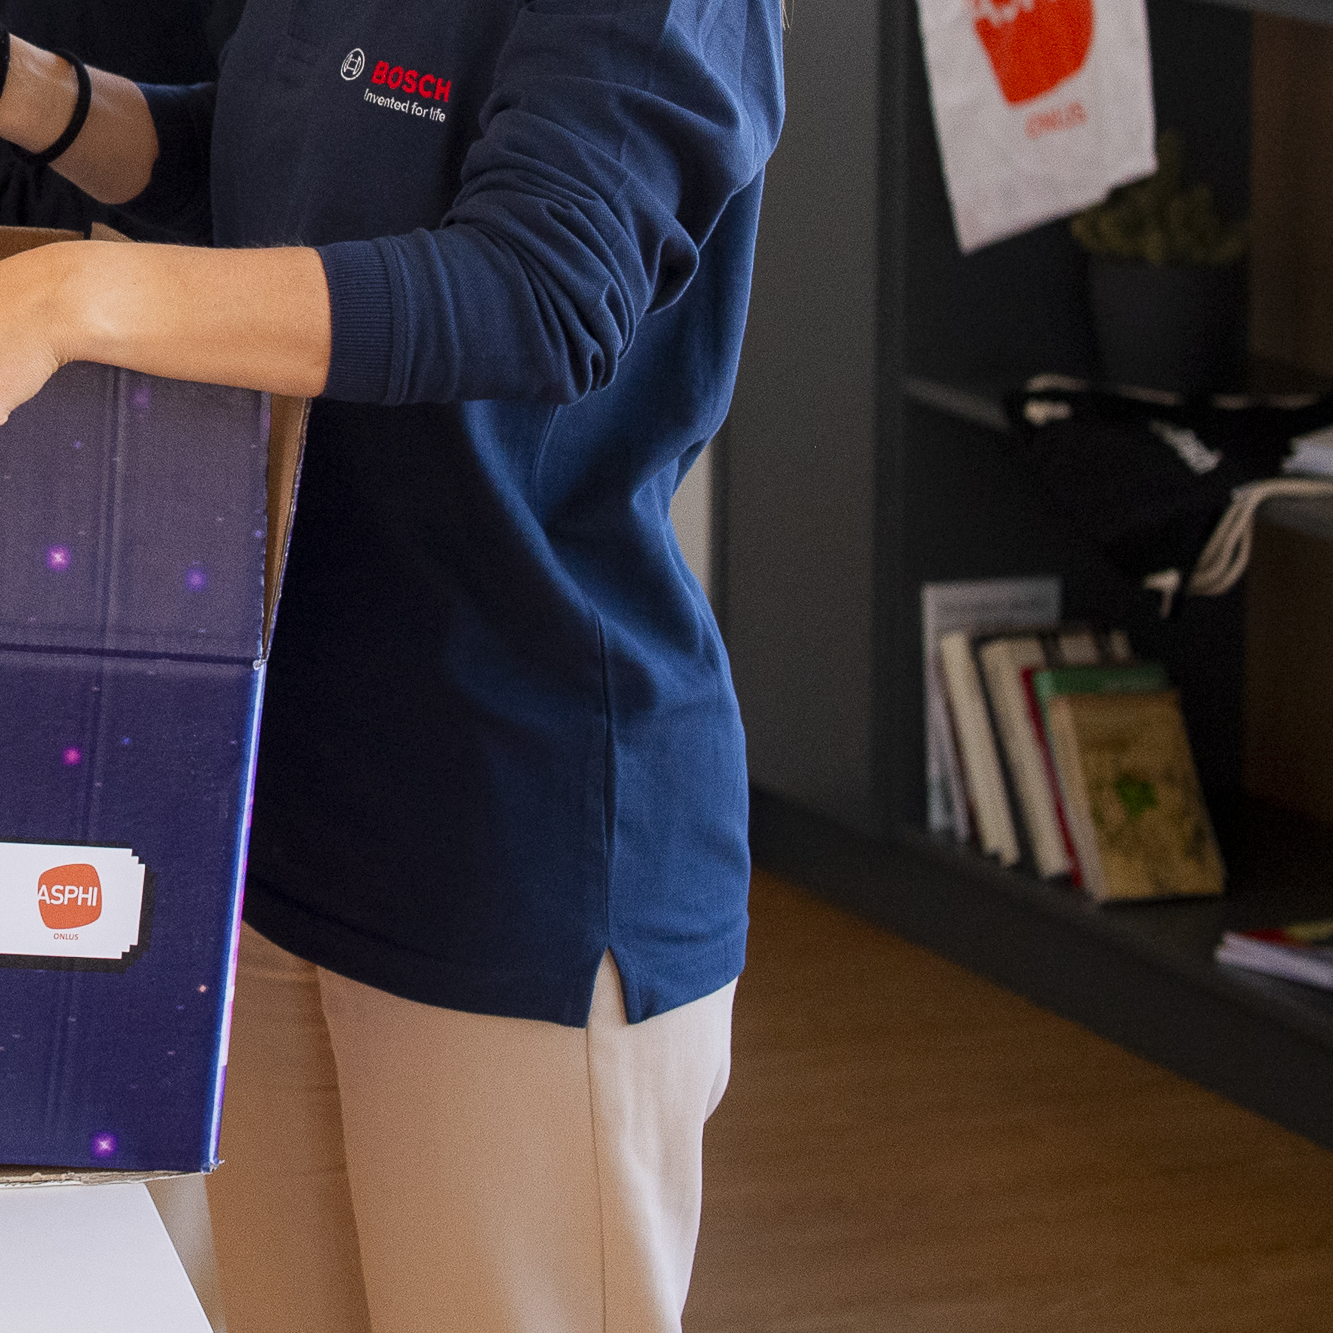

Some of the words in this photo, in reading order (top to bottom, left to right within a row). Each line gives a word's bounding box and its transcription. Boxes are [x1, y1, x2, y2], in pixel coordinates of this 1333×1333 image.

[371, 60, 451, 102] BOSCH
[363, 88, 410, 113] Invented
[411, 102, 428, 118] for
[429, 107, 446, 122] life
[37, 884, 98, 907] ASPHI
[53, 932, 79, 941] ONLUS
